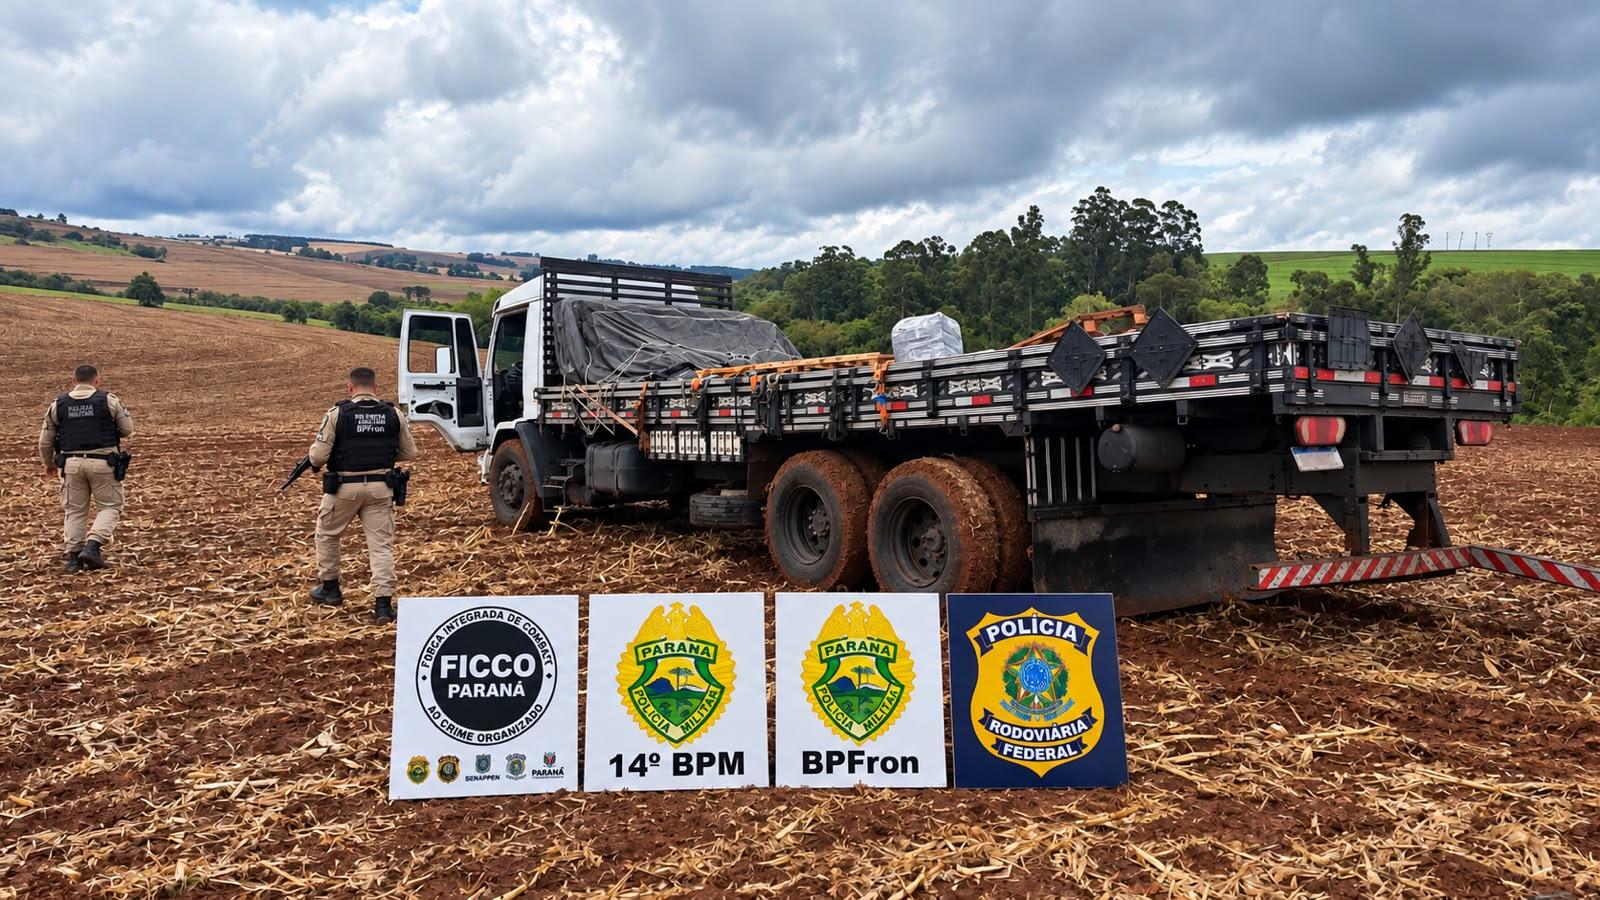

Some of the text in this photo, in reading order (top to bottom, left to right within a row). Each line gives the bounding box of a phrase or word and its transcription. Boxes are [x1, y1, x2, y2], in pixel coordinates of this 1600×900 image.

[443, 610, 504, 635] INTEGRADA
[507, 613, 522, 626] DE
[986, 613, 1077, 643] POLÍCIA
[440, 653, 536, 679] FICCO
[448, 681, 526, 699] PARANÁ
[634, 689, 670, 733] POLICIA
[818, 687, 854, 731] POLICIA
[427, 703, 543, 743] AO CRIME ORGANIZADO
[989, 719, 1088, 741] RODOVIÁRIA
[609, 751, 745, 777] 14º BPM
[802, 750, 920, 775] BPFron
[1002, 742, 1078, 761] FEDERAL
[531, 767, 564, 776] PARANÁ
